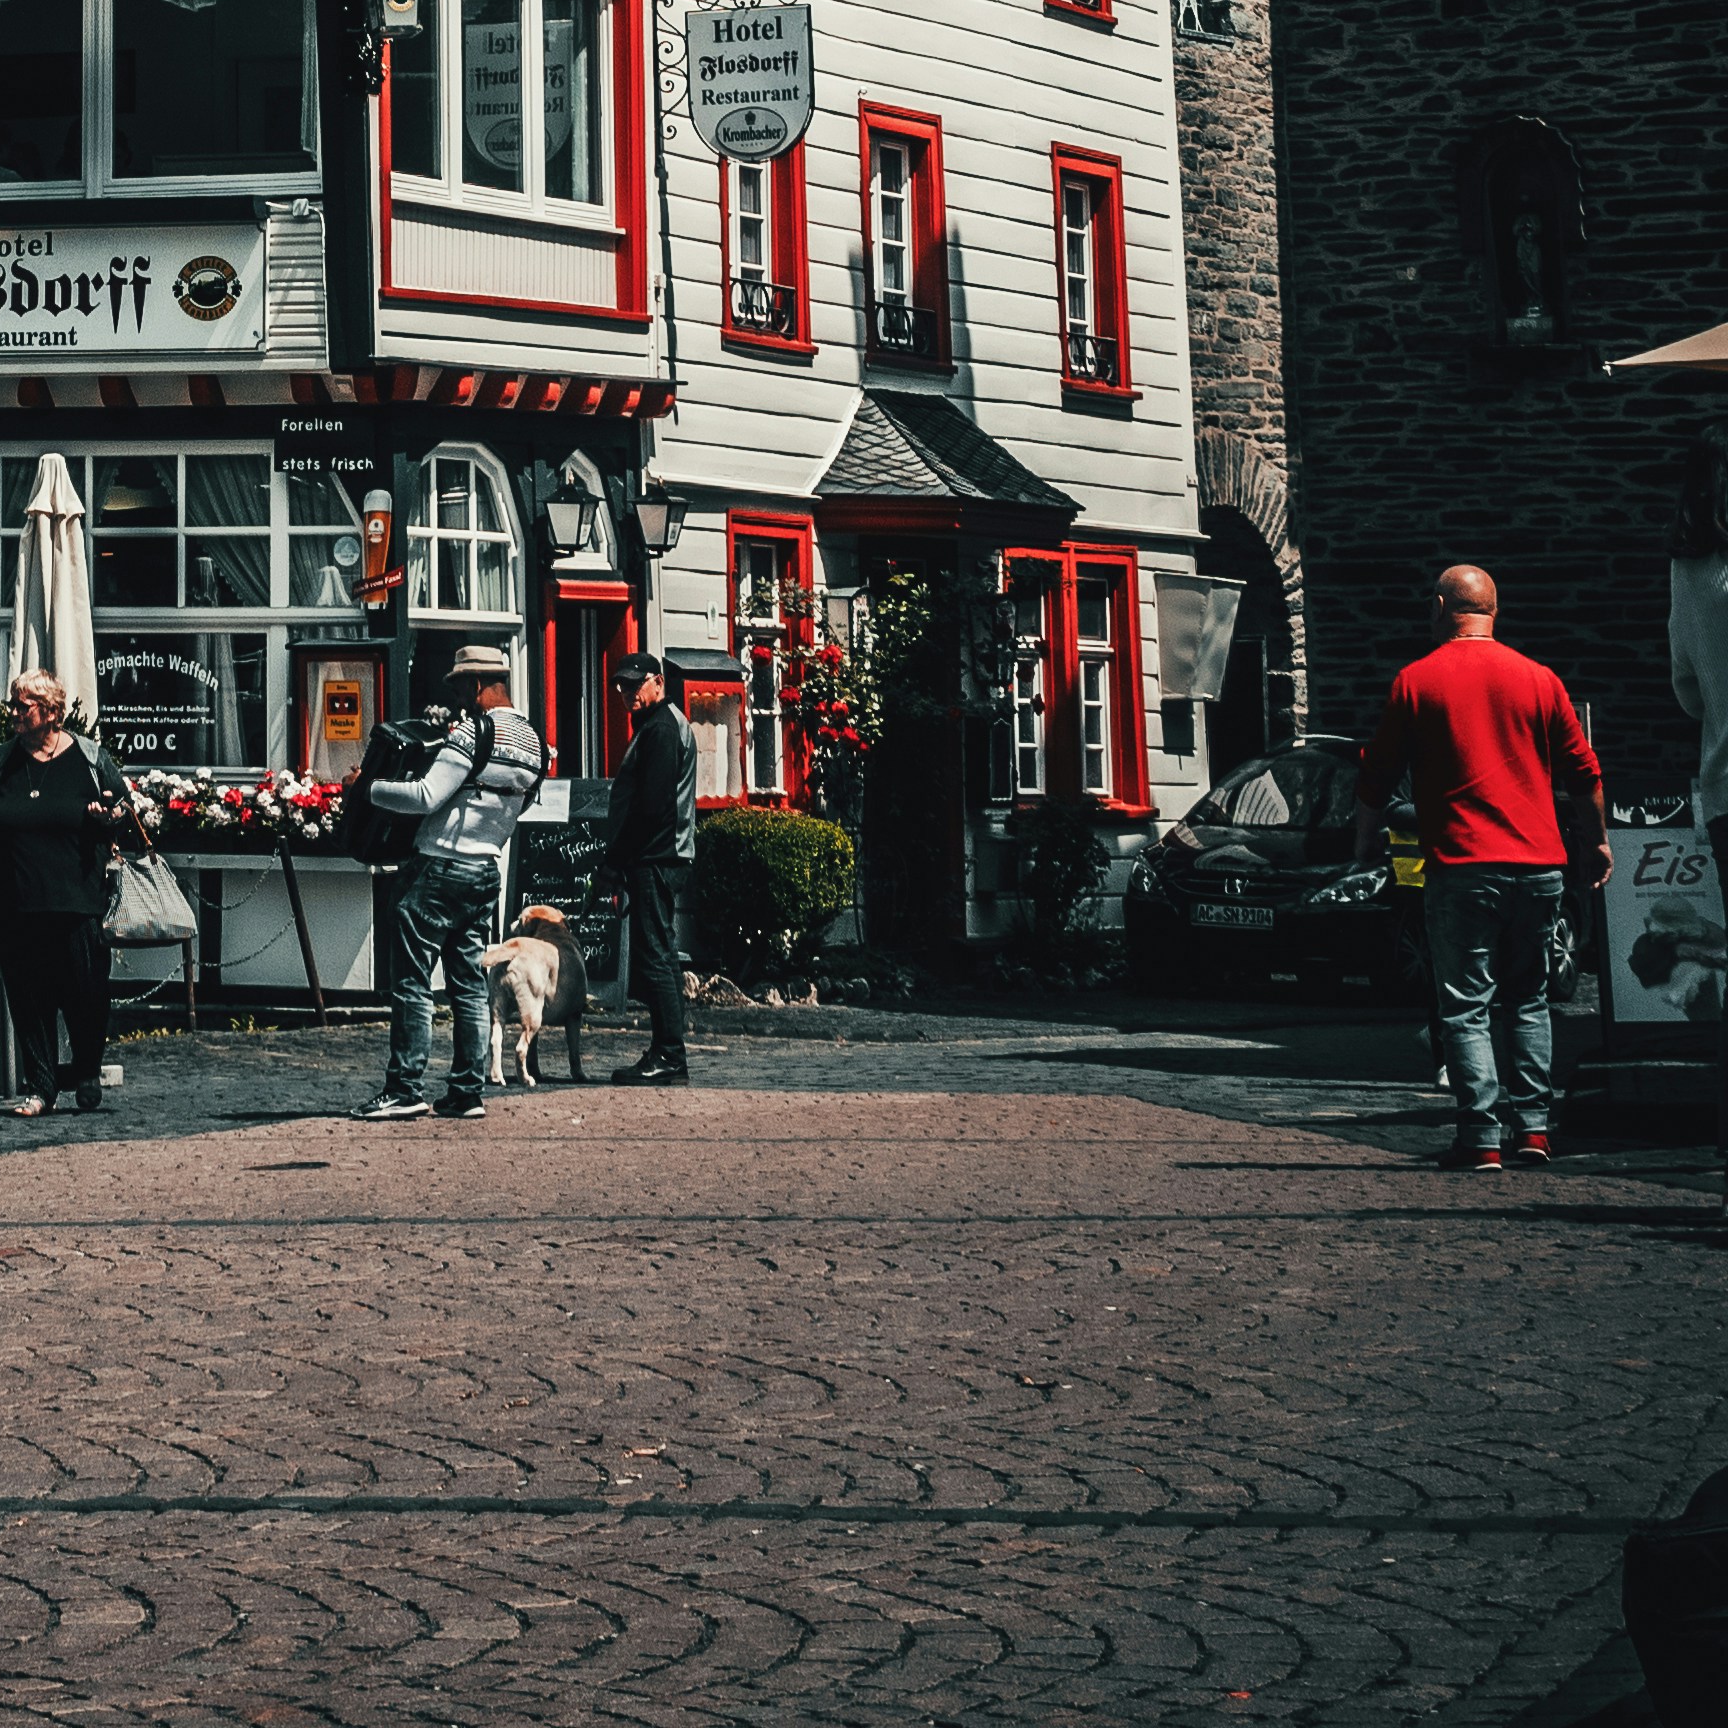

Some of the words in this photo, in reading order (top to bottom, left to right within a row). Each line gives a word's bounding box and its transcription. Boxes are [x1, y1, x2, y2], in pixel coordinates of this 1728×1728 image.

[712, 16, 783, 43] Hotel
[699, 51, 798, 81] Flosdorff
[701, 85, 800, 106] Restaurant
[723, 125, 781, 142] Krombacher
[281, 418, 343, 431] Forellen
[283, 458, 320, 470] stets
[331, 457, 374, 470] frisch
[169, 654, 219, 691] Waffeln
[116, 734, 158, 754] 7,00
[165, 734, 176, 750] €
[1633, 840, 1709, 887] Eis
